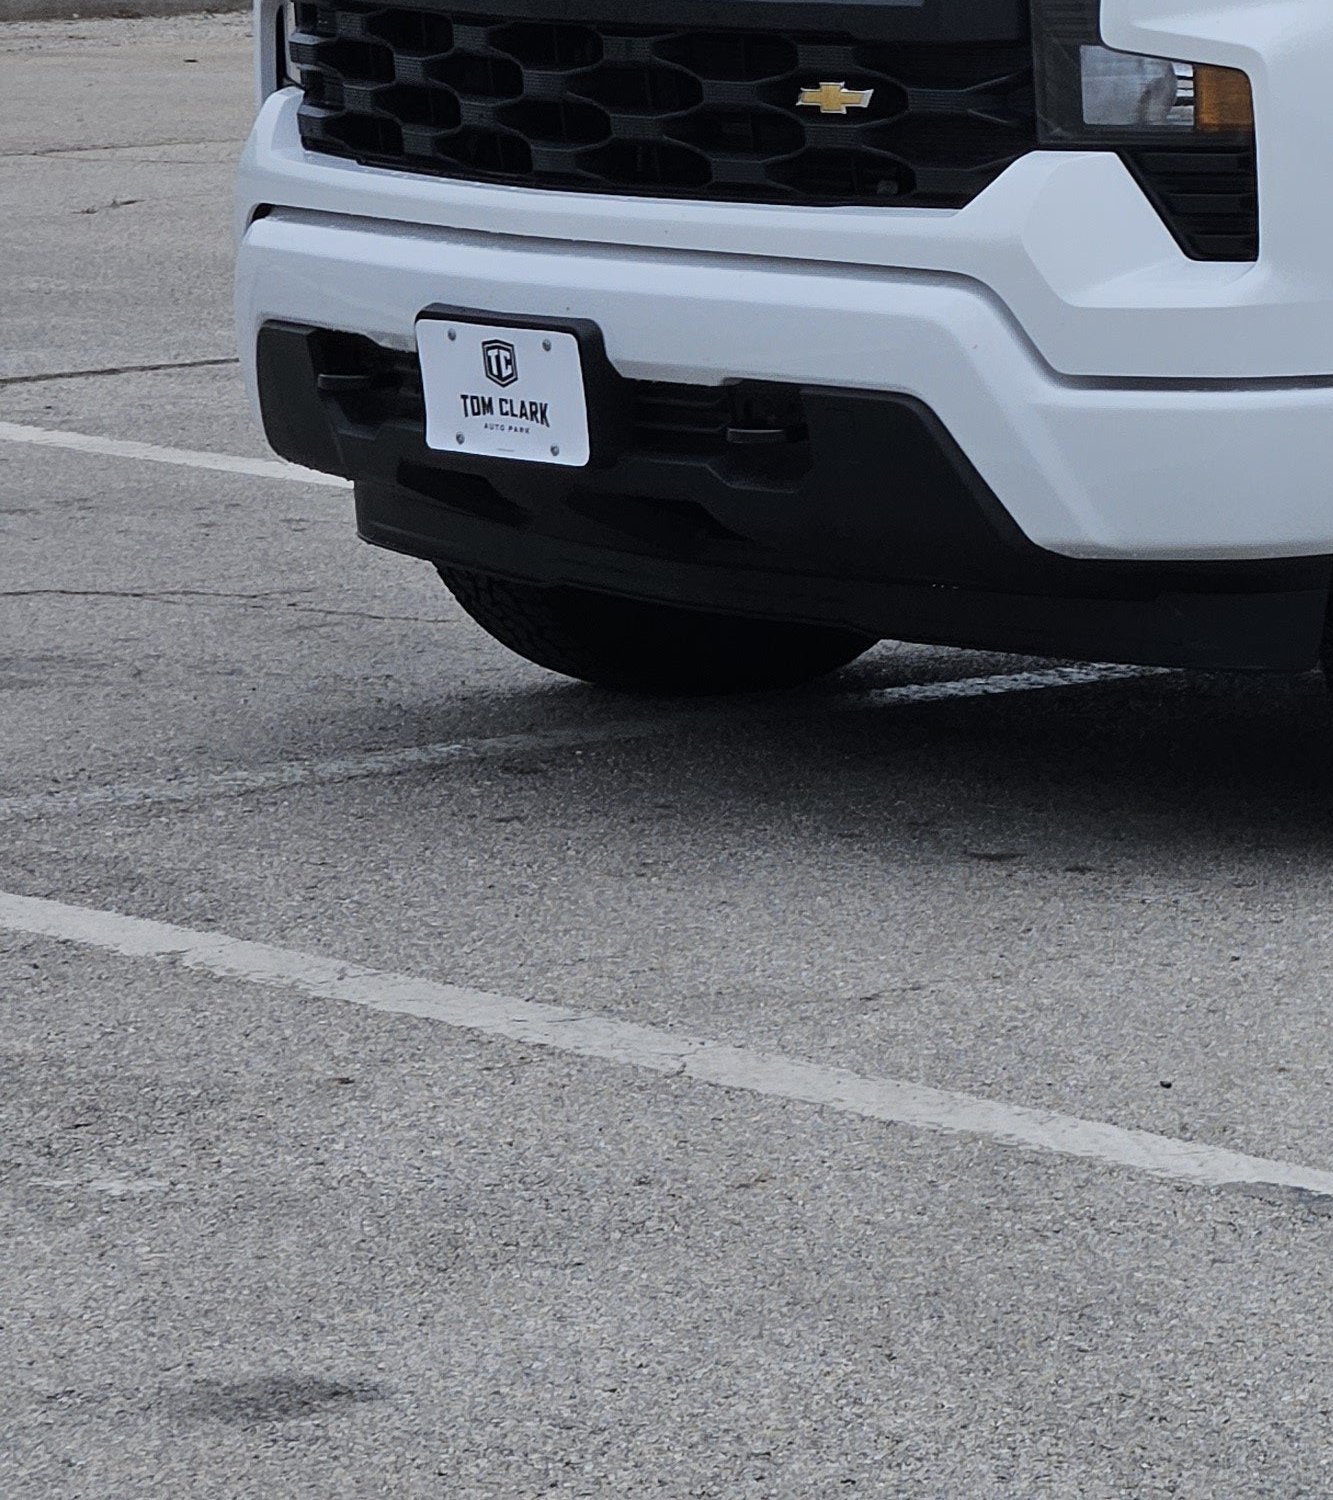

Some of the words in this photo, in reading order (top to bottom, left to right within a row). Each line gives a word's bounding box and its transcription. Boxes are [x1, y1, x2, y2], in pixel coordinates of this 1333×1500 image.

[460, 393, 494, 418] TOM
[499, 397, 550, 428] CLARK
[483, 422, 505, 432] AUTO
[508, 424, 531, 435] PARK
